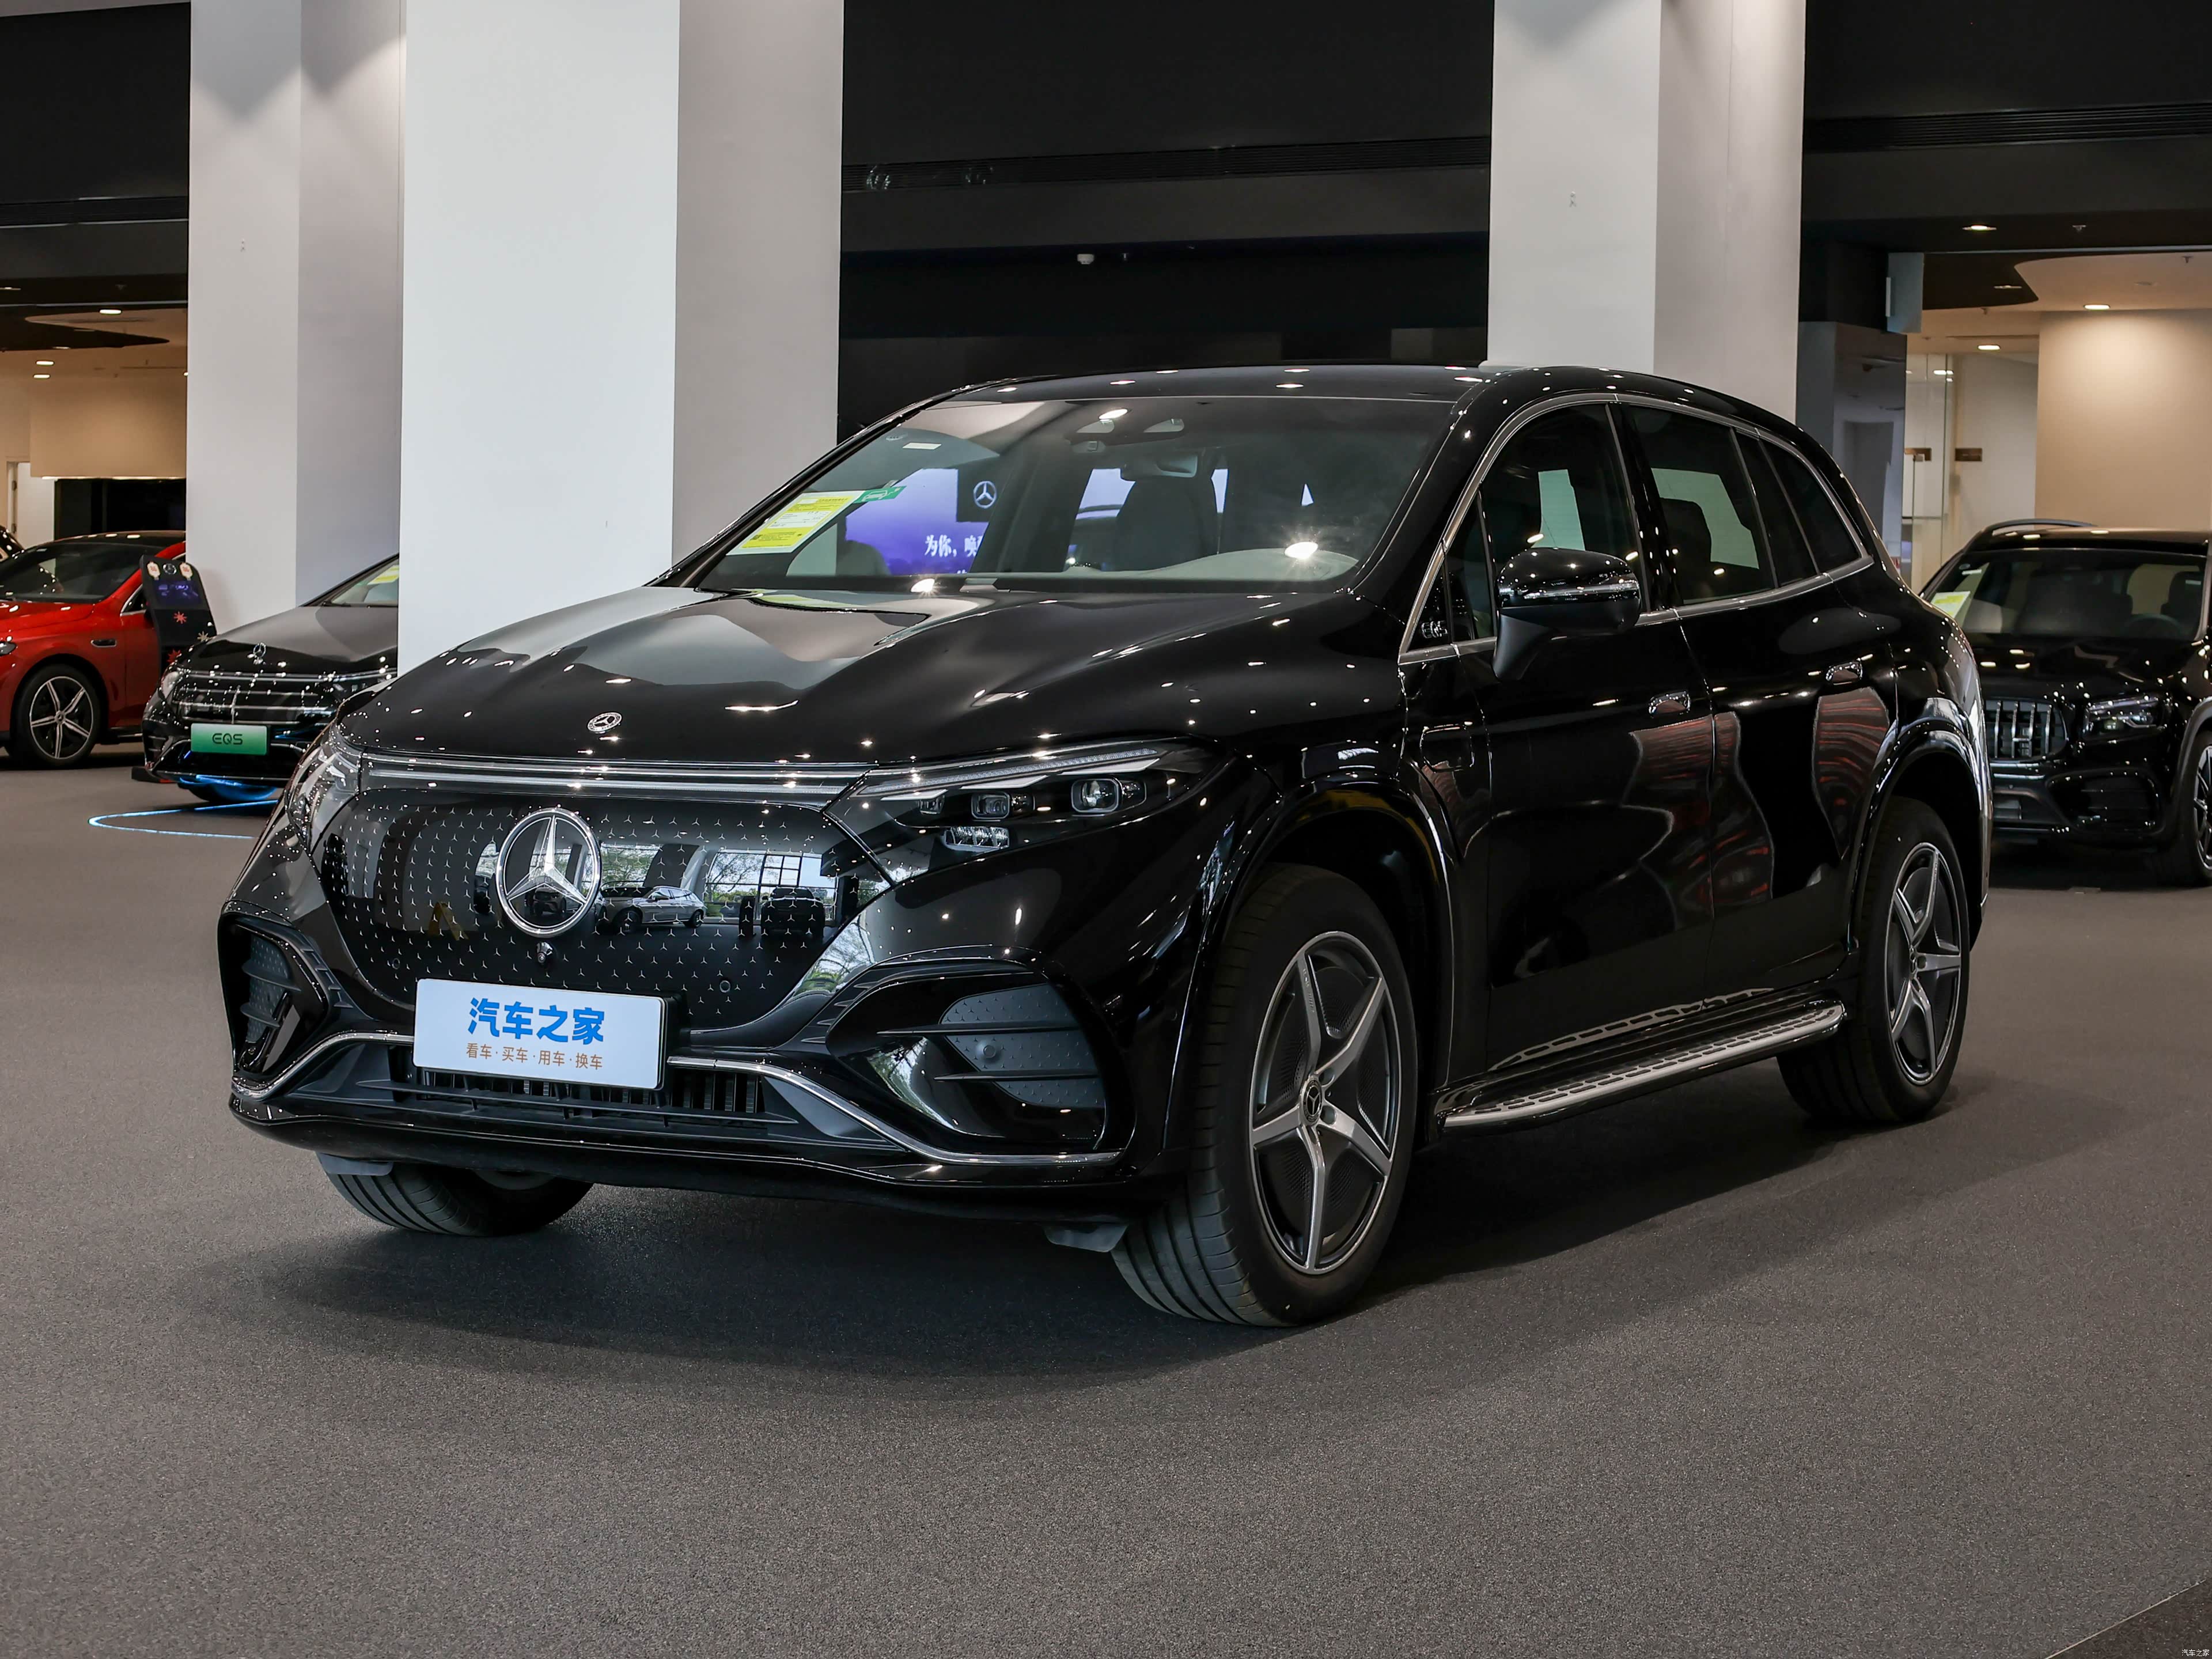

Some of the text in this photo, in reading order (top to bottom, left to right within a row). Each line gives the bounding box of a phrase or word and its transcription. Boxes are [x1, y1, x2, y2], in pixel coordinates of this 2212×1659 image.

[924, 535, 983, 558] 为你，唤
[212, 733, 243, 745] EQS
[468, 997, 605, 1046] 汽车之家
